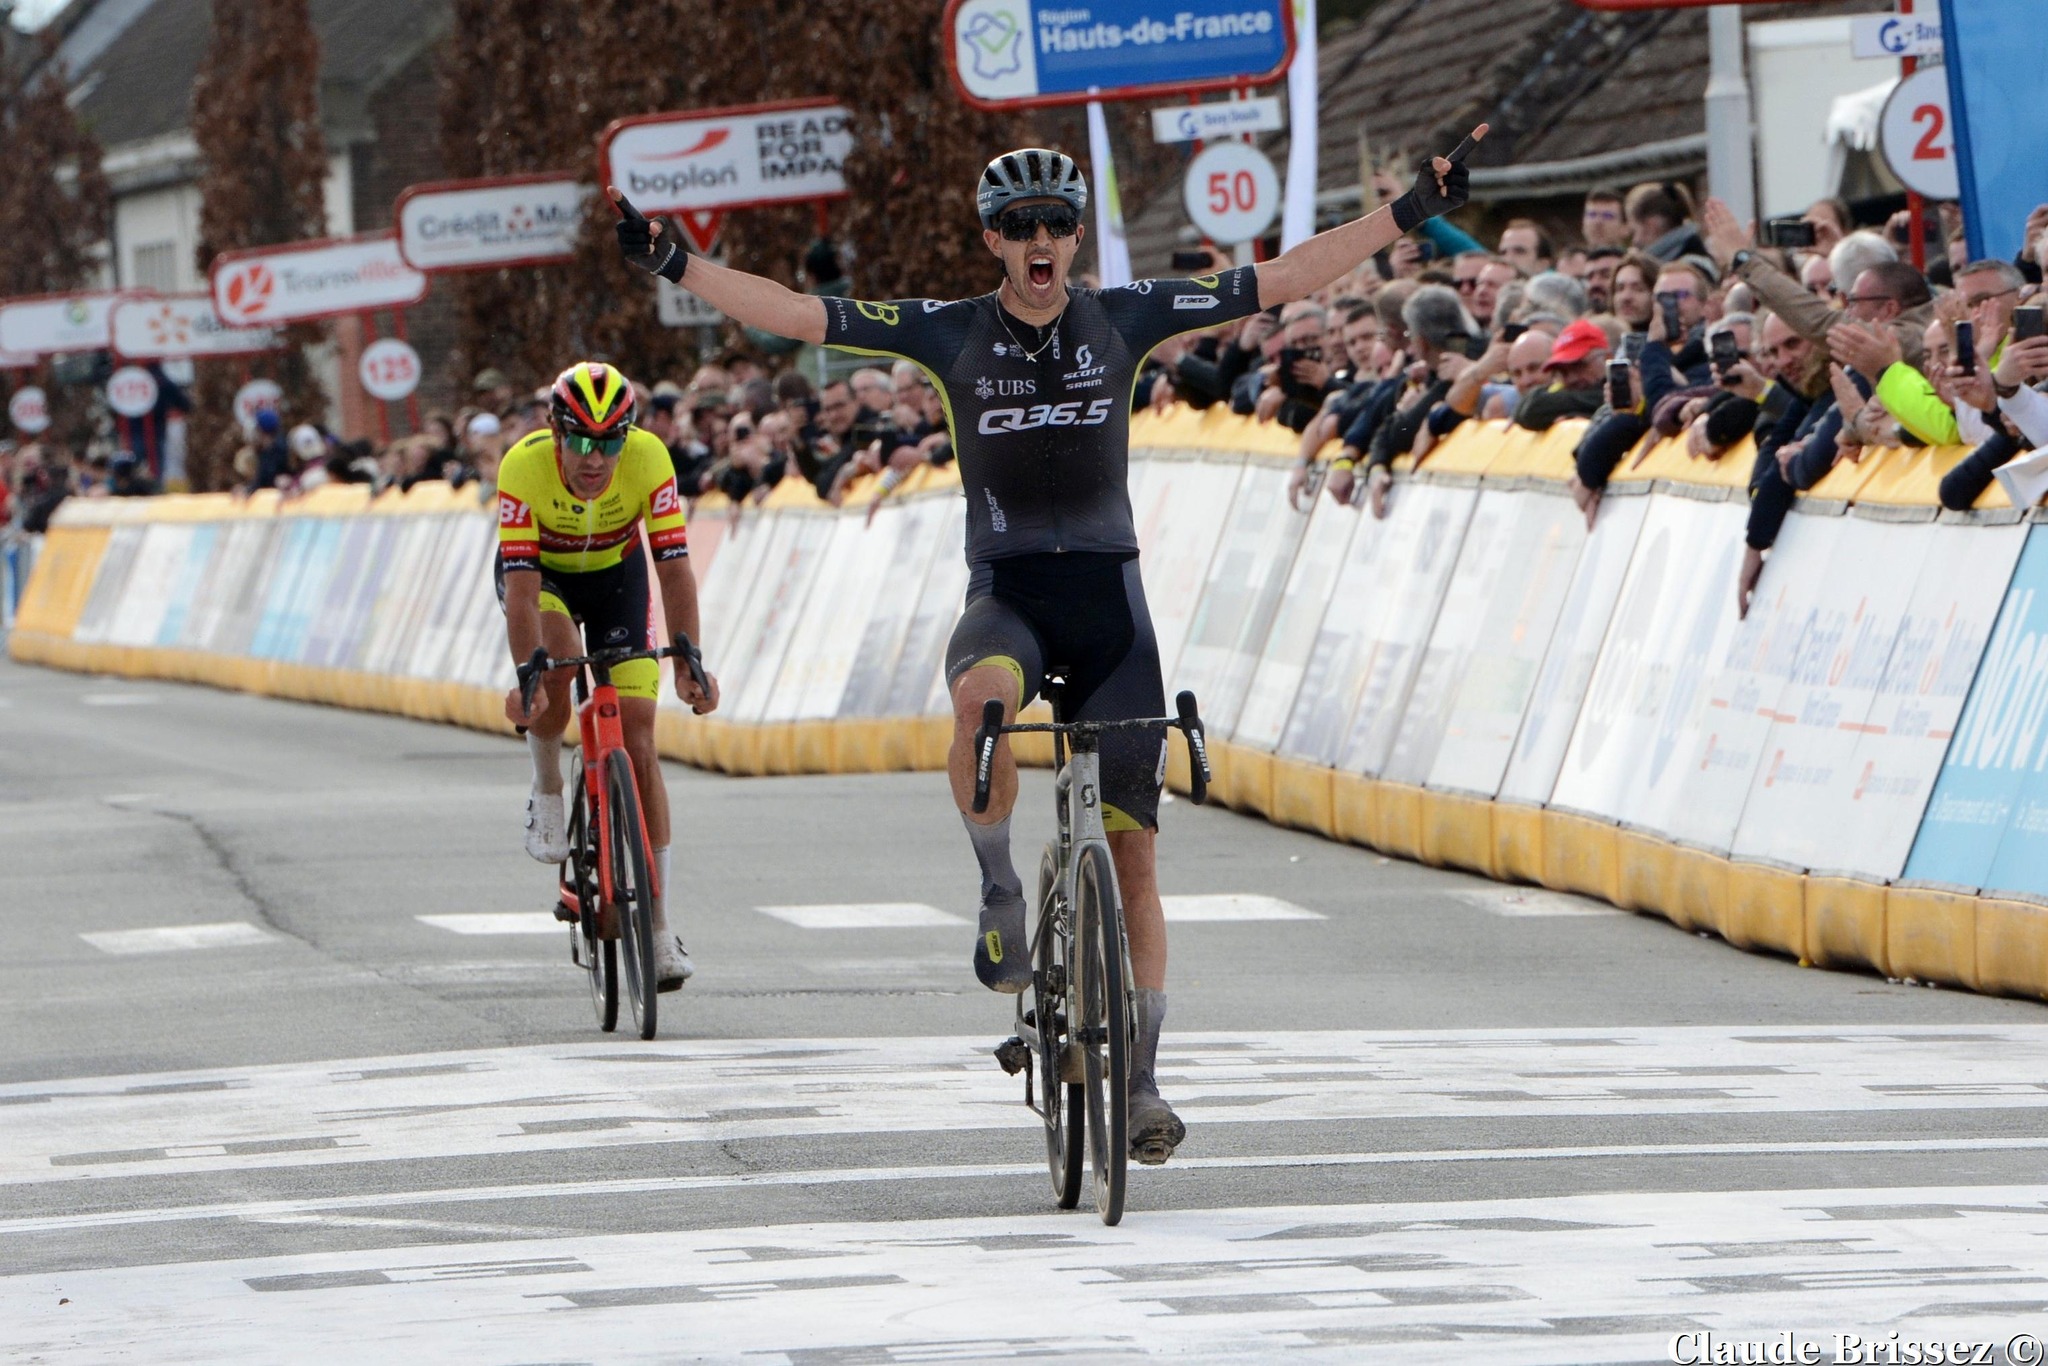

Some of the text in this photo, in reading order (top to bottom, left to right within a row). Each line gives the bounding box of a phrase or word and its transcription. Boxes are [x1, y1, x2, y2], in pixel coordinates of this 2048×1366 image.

[1038, 8, 1089, 25] Région
[1039, 10, 1272, 54] Hauts-de-France
[759, 140, 821, 159] FOR
[627, 161, 737, 195] boplan
[1207, 171, 1257, 214] 50
[418, 210, 501, 239] Crédit
[367, 361, 414, 385] 125
[1062, 365, 1106, 380] SCOTT
[1066, 379, 1103, 390] SRAM
[997, 379, 1036, 396] UBS
[978, 398, 1113, 435] Q36.5
[653, 475, 677, 513] B!
[500, 498, 530, 523] B!
[978, 736, 993, 783] SRAM
